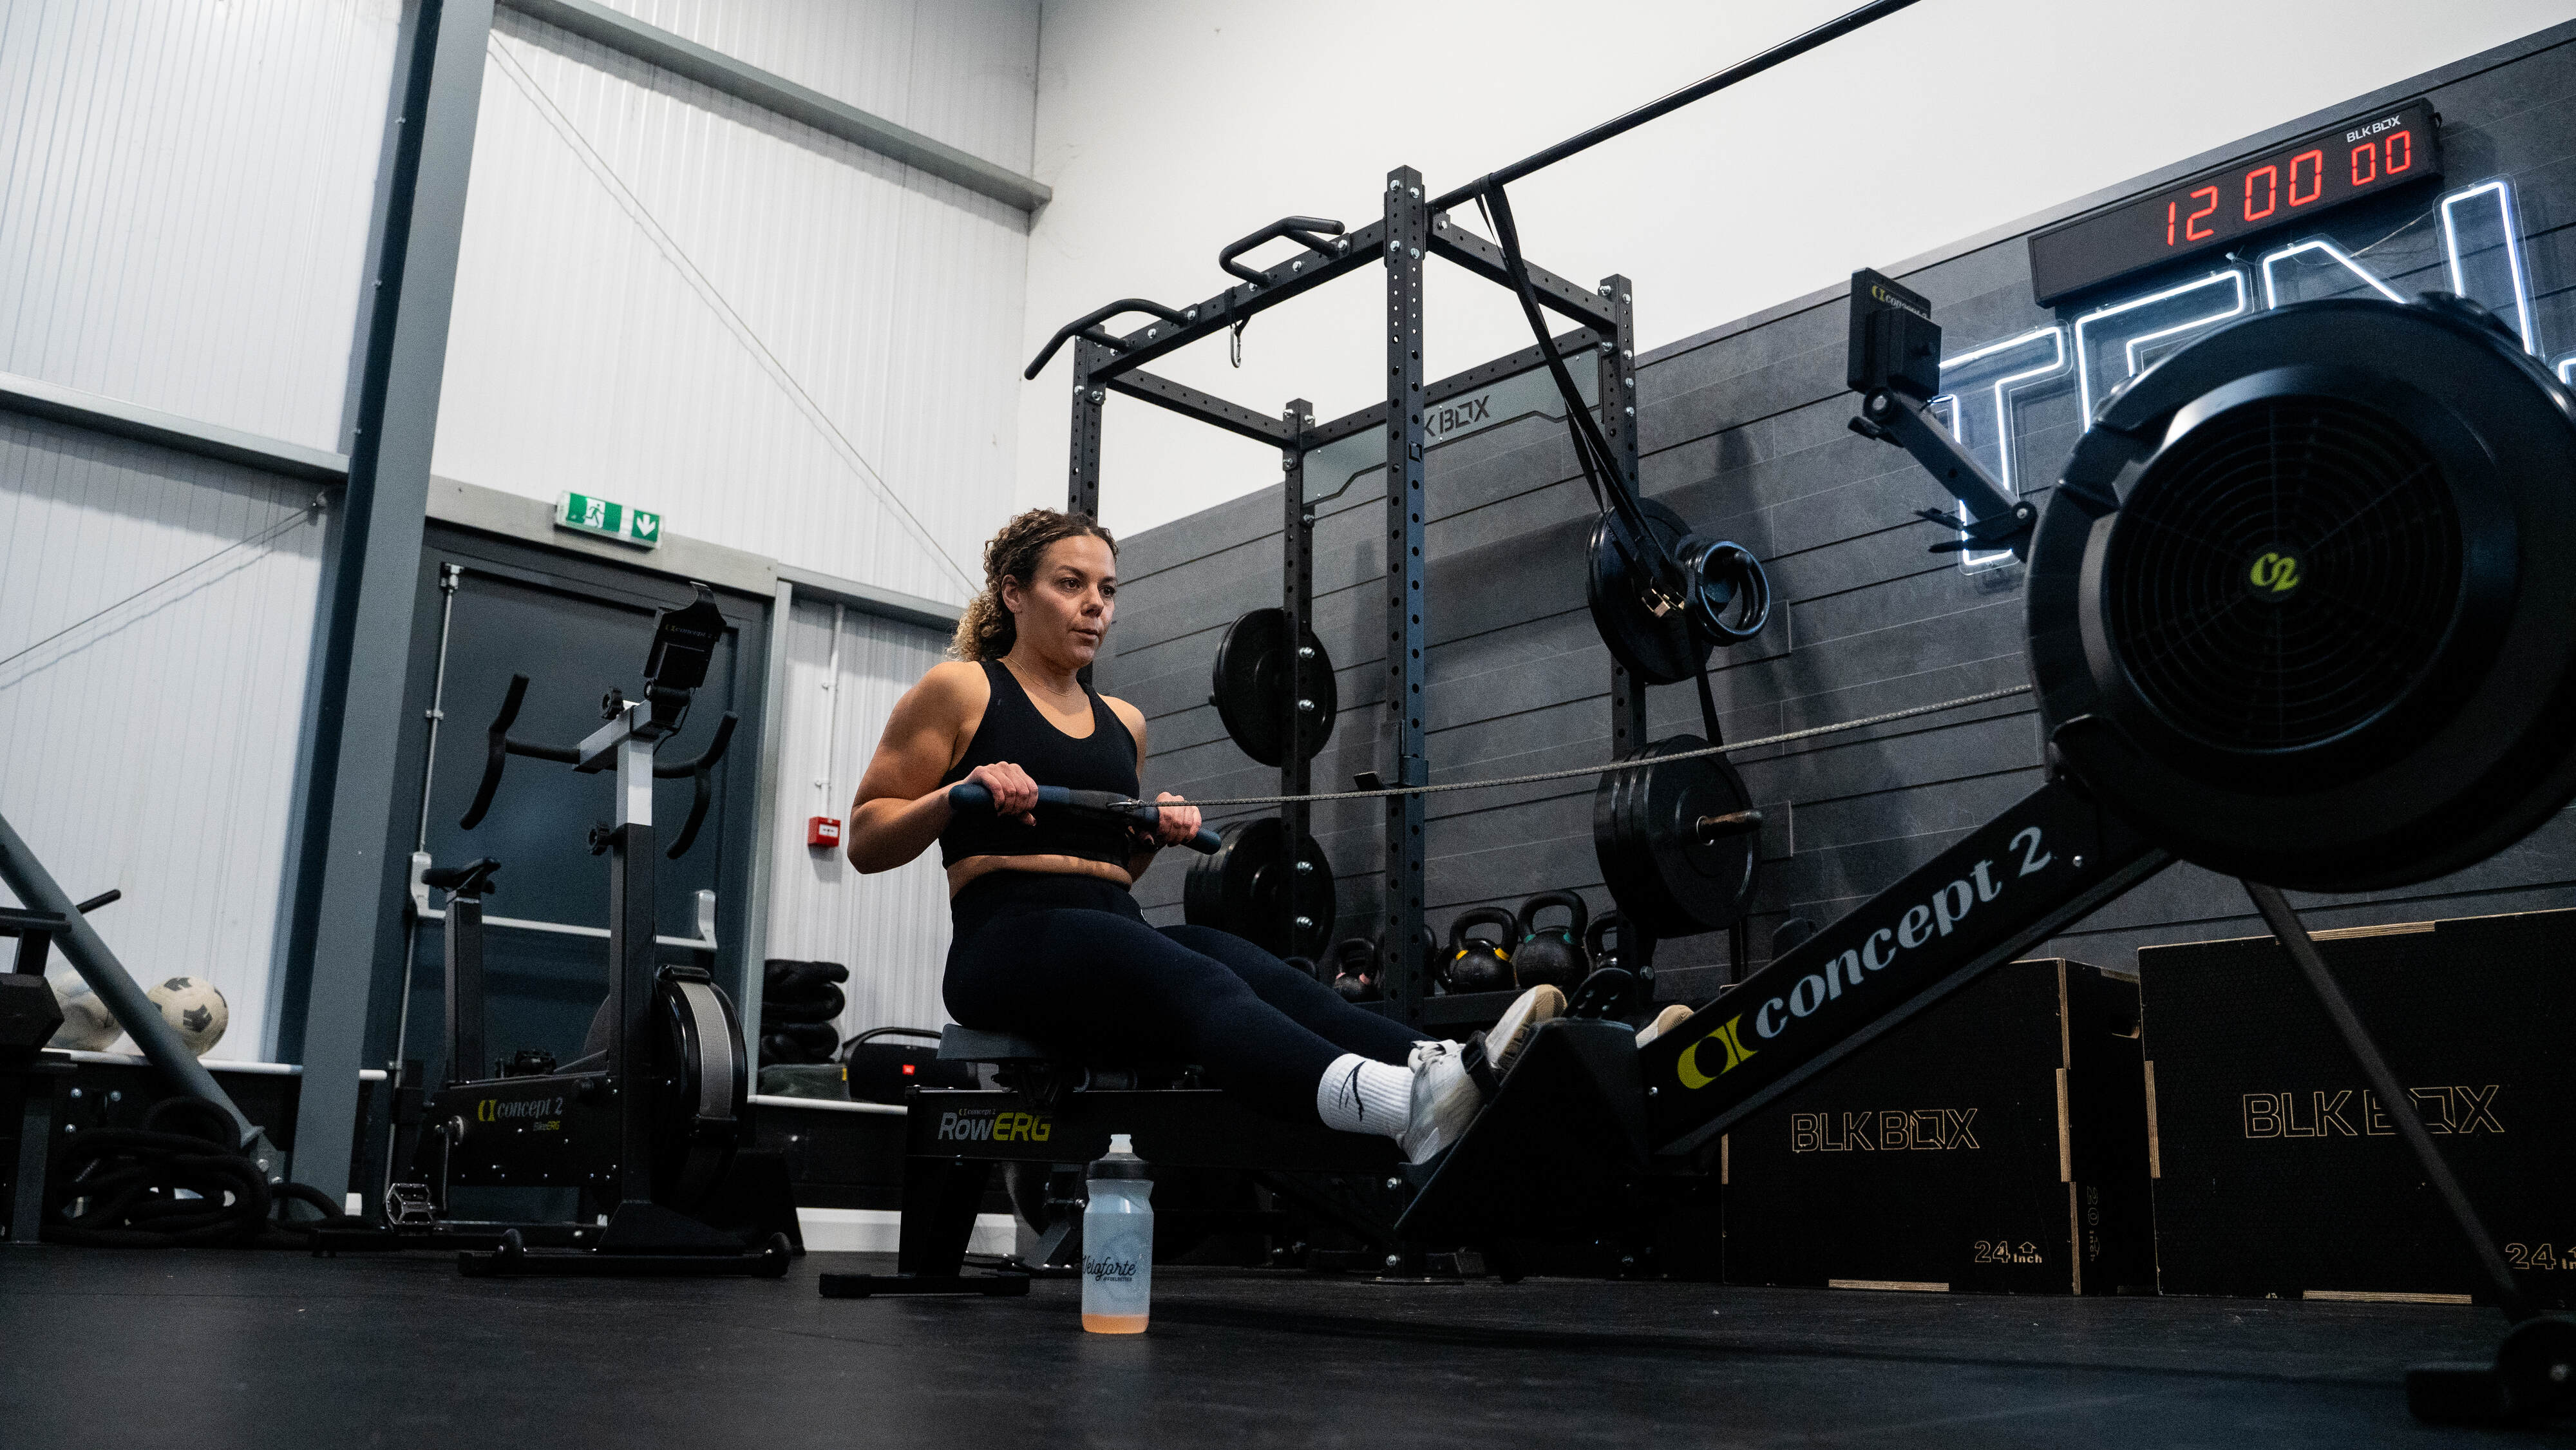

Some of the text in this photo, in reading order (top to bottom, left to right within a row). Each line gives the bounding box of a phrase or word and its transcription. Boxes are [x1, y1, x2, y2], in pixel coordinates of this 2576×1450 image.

[2346, 115, 2401, 142] BLK BOX
[2167, 130, 2410, 246] 12 00 00
[1440, 394, 1490, 434] BOX
[2249, 552, 2301, 593] C2
[1756, 826, 2052, 1038] concept 2
[497, 1096, 564, 1119] concept 2
[938, 1112, 1052, 1141] RowERG
[2243, 1090, 2358, 1138] BLK
[1792, 1108, 1980, 1152] BLK BOX
[1974, 1240, 2011, 1263] 24
[2505, 1243, 2576, 1270] 24 In
